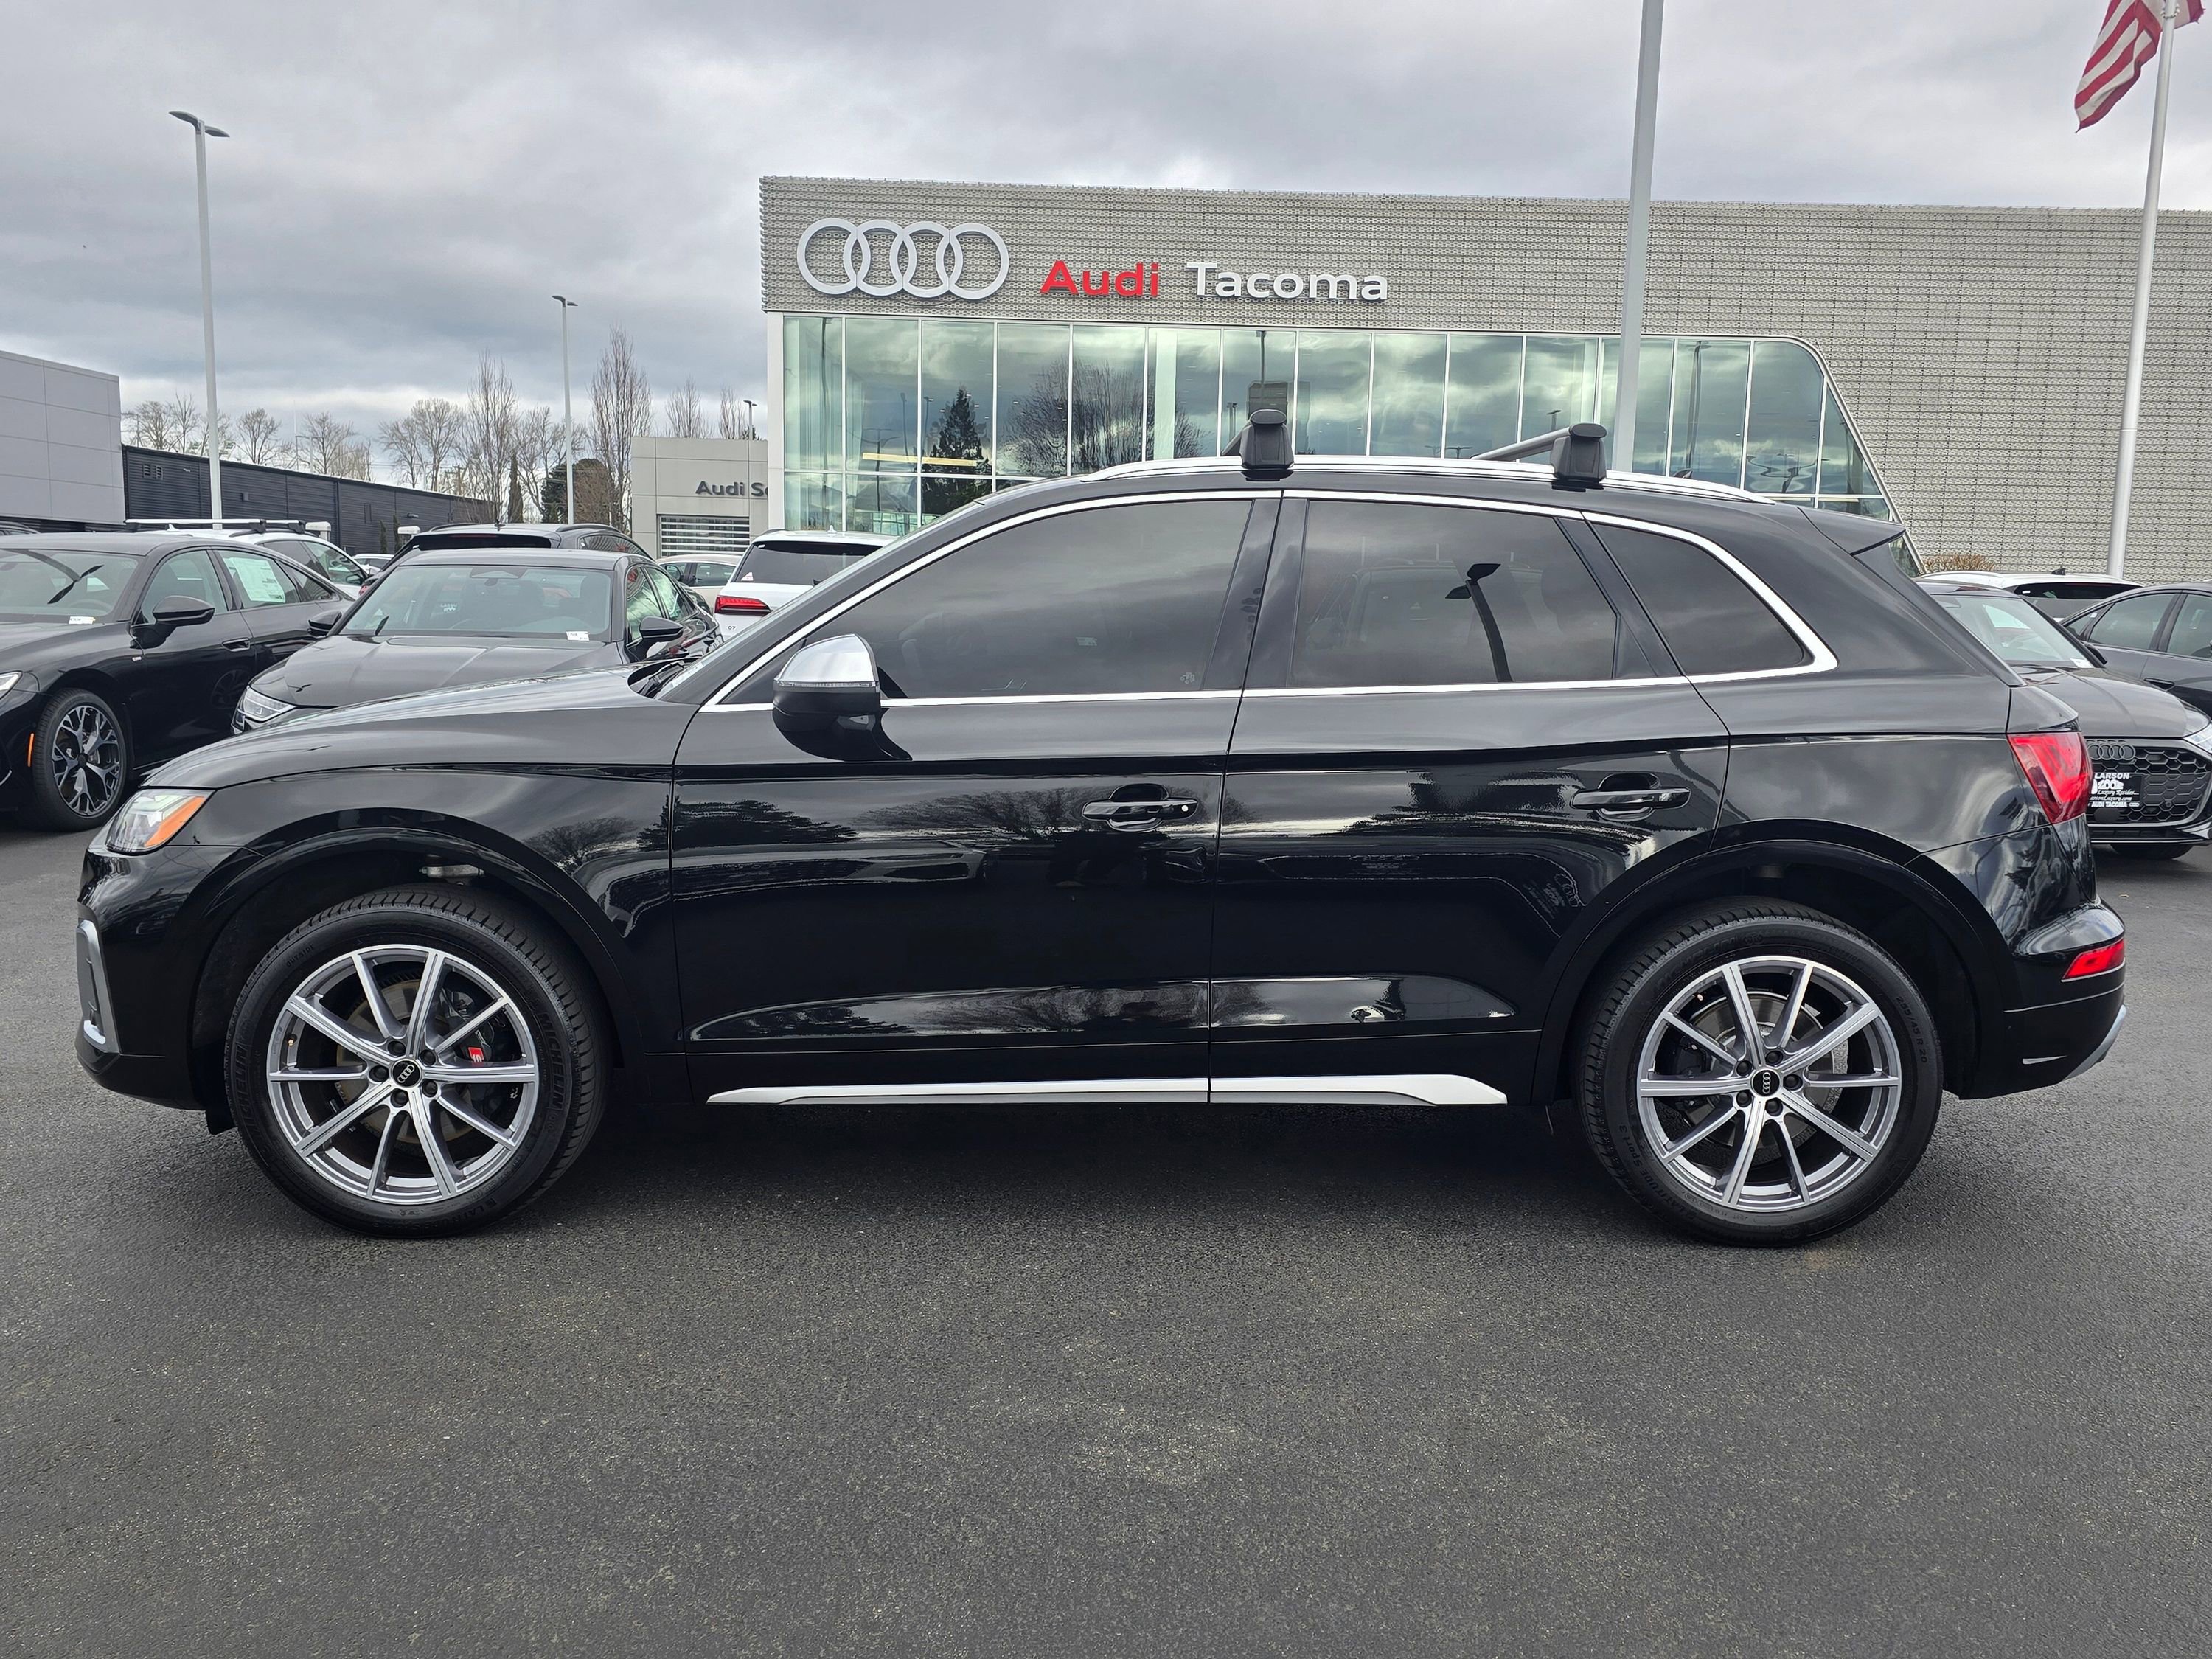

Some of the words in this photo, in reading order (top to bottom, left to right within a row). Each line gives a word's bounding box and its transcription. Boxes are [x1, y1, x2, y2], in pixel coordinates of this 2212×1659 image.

[1040, 260, 1160, 296] Audi
[1186, 262, 1389, 300] Tacoma
[695, 481, 745, 496] Audi
[751, 482, 768, 496] S
[1896, 995, 1922, 1036] 255/45
[1916, 1037, 1924, 1046] R
[1919, 1048, 1929, 1064] 20
[538, 1013, 566, 1109] MICHELIN
[1618, 1124, 1628, 1133] 3
[1623, 1136, 1645, 1167] Sport
[1639, 1168, 1687, 1215] LATITUDE
